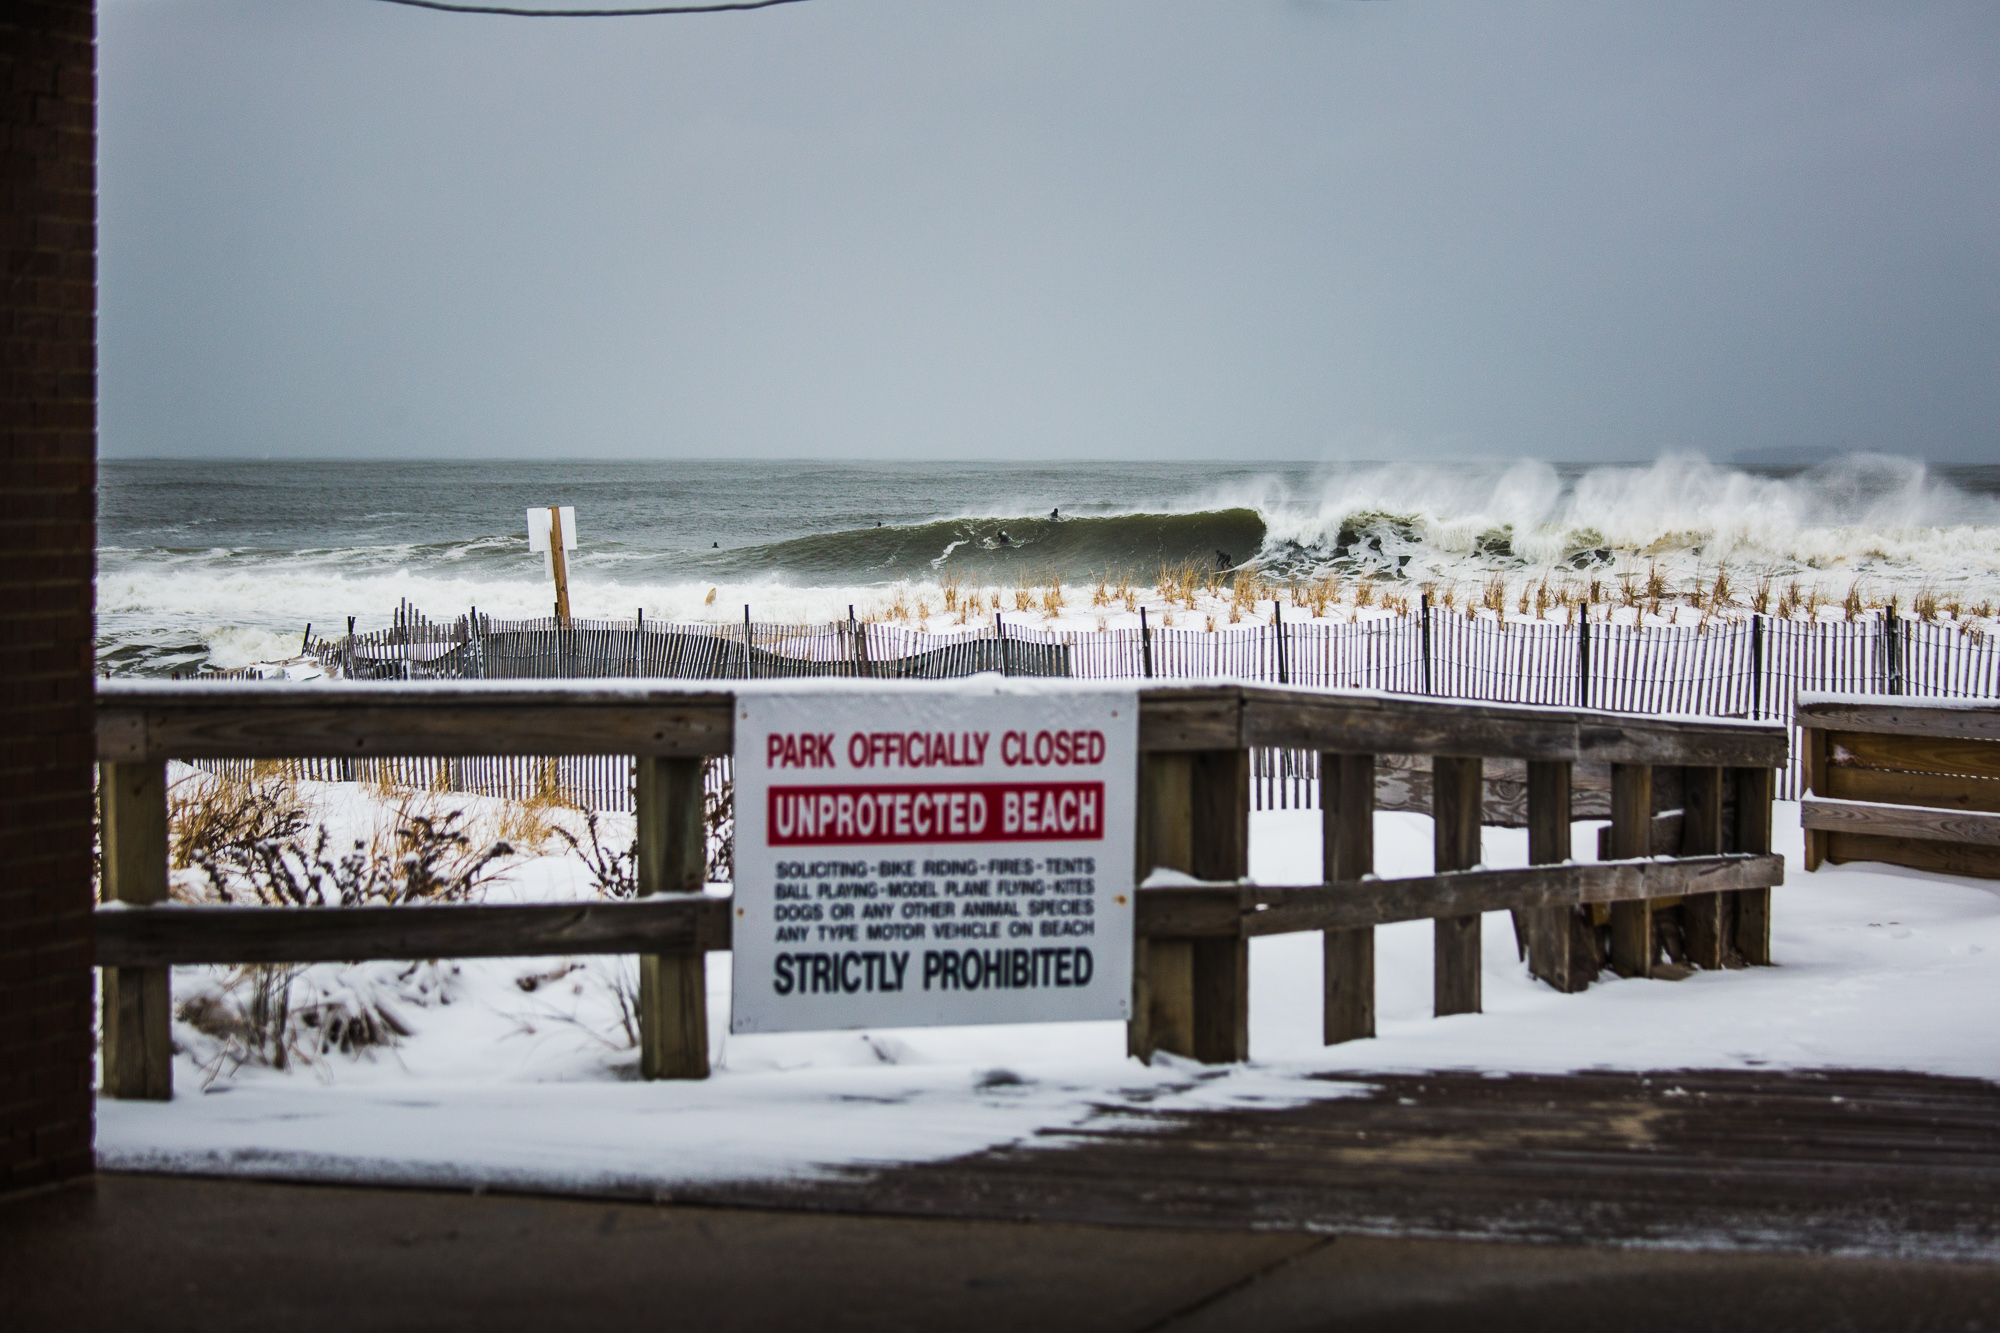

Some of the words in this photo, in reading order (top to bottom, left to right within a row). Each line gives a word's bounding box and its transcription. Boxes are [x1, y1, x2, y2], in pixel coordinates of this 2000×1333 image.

[767, 732, 835, 769] PARK
[848, 732, 990, 768] OFFICIALLY
[1001, 730, 1105, 767] CLOSED
[775, 793, 988, 837] UNPROTECTED
[1003, 790, 1096, 833] BEACH
[775, 883, 811, 901] BALL
[945, 880, 990, 897] PLANE
[774, 904, 823, 922] DOGS
[830, 904, 855, 921] OR
[861, 903, 895, 920] ANY
[901, 902, 955, 919] OTHER
[962, 901, 1020, 917] ANIMAL
[1027, 899, 1095, 917] SPECIES
[774, 926, 811, 943] ANY
[817, 925, 858, 942] TYPE
[866, 924, 925, 941] MOTOR
[932, 923, 999, 940] VEHICLE
[1008, 922, 1033, 939] ON
[1039, 921, 1094, 937] BEACH
[773, 950, 910, 995] STRICTLY
[922, 947, 1094, 992] PROHIBITED
